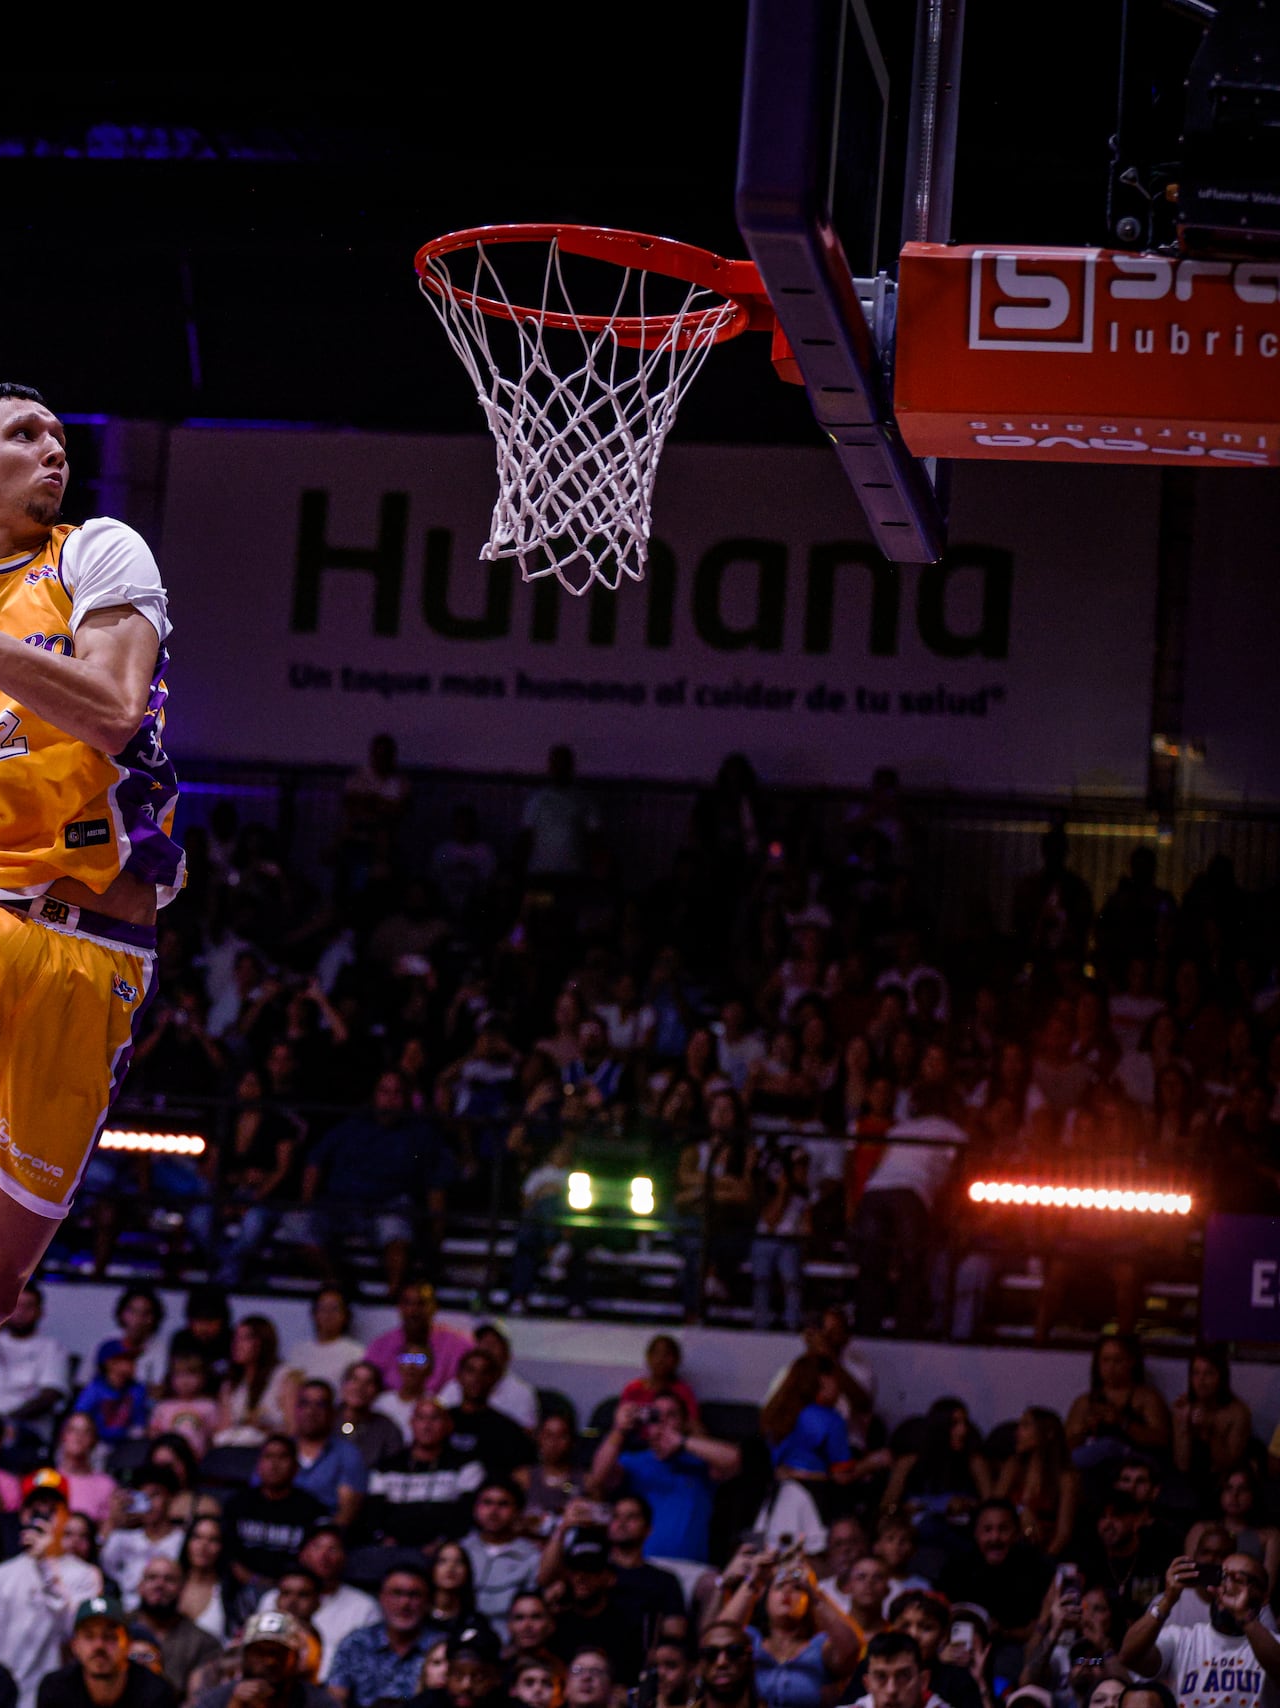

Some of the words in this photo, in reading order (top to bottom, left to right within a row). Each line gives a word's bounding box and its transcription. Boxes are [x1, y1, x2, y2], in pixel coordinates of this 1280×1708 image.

[290, 488, 1016, 661] Humana
[289, 663, 332, 690] Un
[341, 666, 430, 699] toque
[516, 670, 646, 706] humano
[695, 679, 797, 711] cuidar
[806, 680, 847, 713] de
[855, 685, 890, 715] tu
